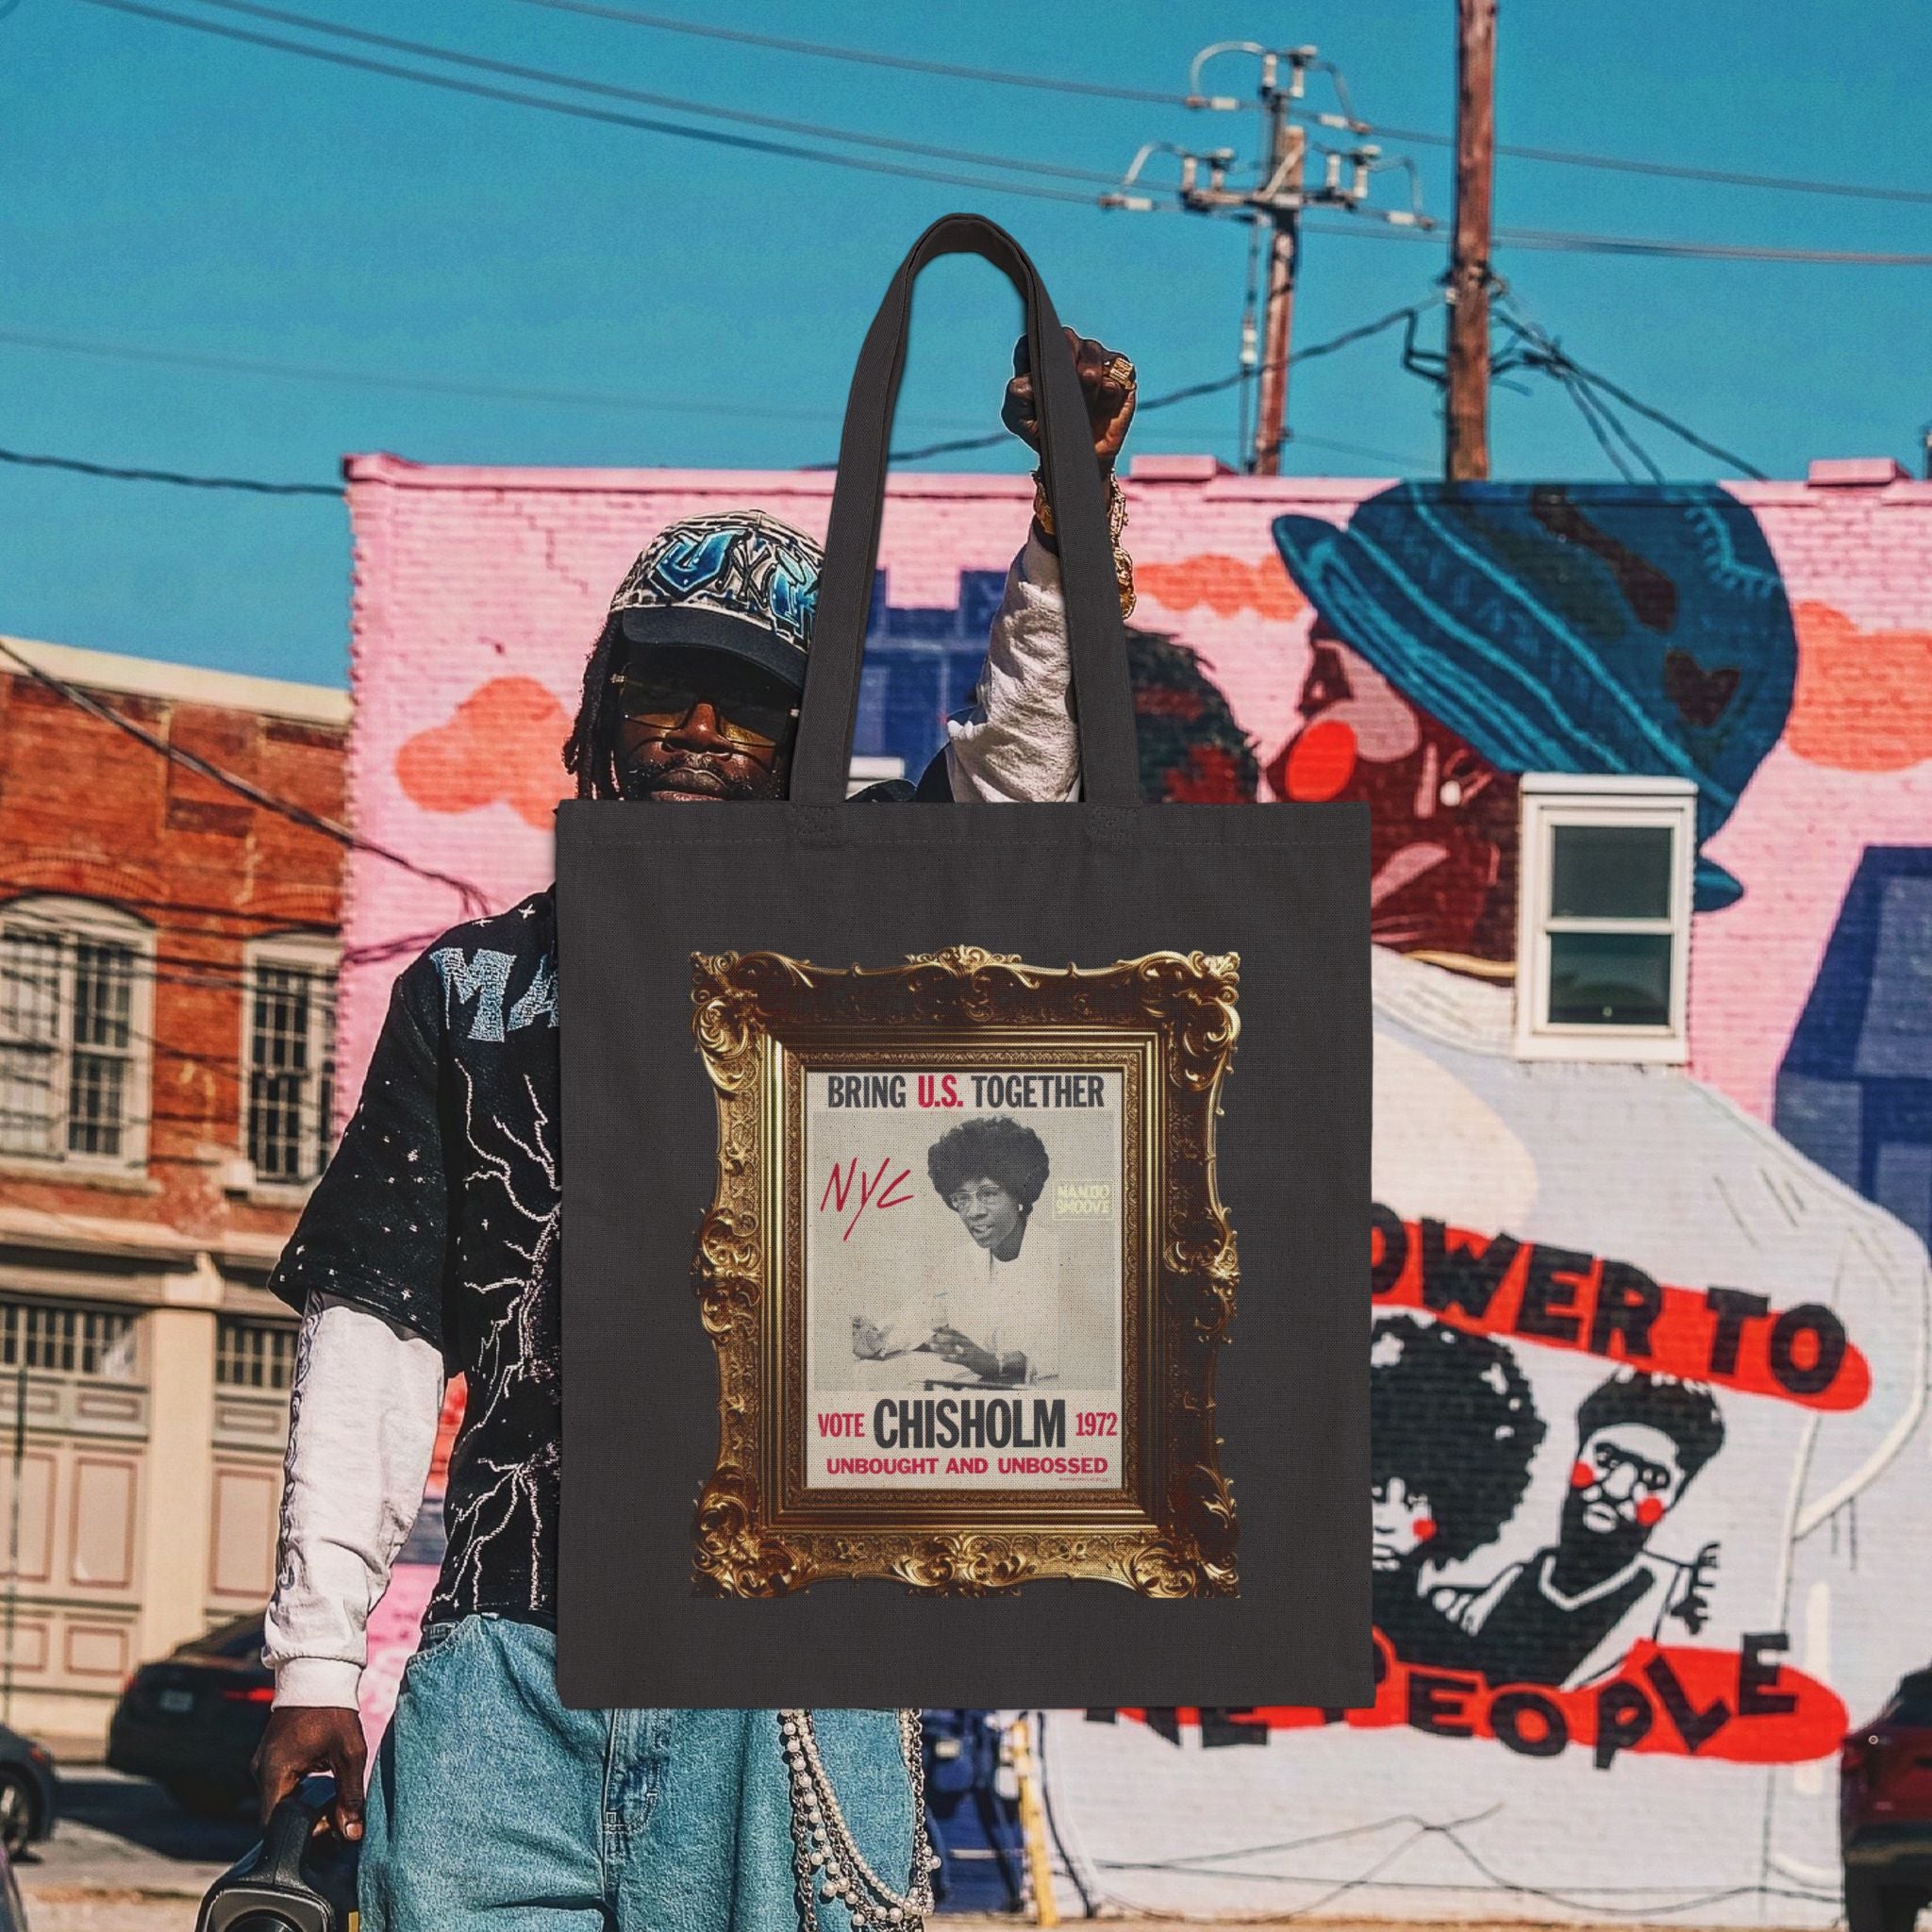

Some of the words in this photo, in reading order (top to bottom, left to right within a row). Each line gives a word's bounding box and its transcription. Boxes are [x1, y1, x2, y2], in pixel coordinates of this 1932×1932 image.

[828, 1075, 906, 1108] BRING
[917, 1074, 964, 1108] U.S.
[971, 1075, 1105, 1108] TOGETHER
[820, 1157, 914, 1242] NYC
[1707, 1286, 1847, 1394] TO
[817, 1412, 865, 1438] VOTE
[874, 1399, 1066, 1448] CHISHOLM
[1075, 1412, 1118, 1437] 1972
[826, 1457, 939, 1475] UNBOUGHT
[945, 1457, 989, 1474] AND
[998, 1457, 1108, 1474] UNBOSSED
[1324, 1632, 1799, 1771] EOPLE
